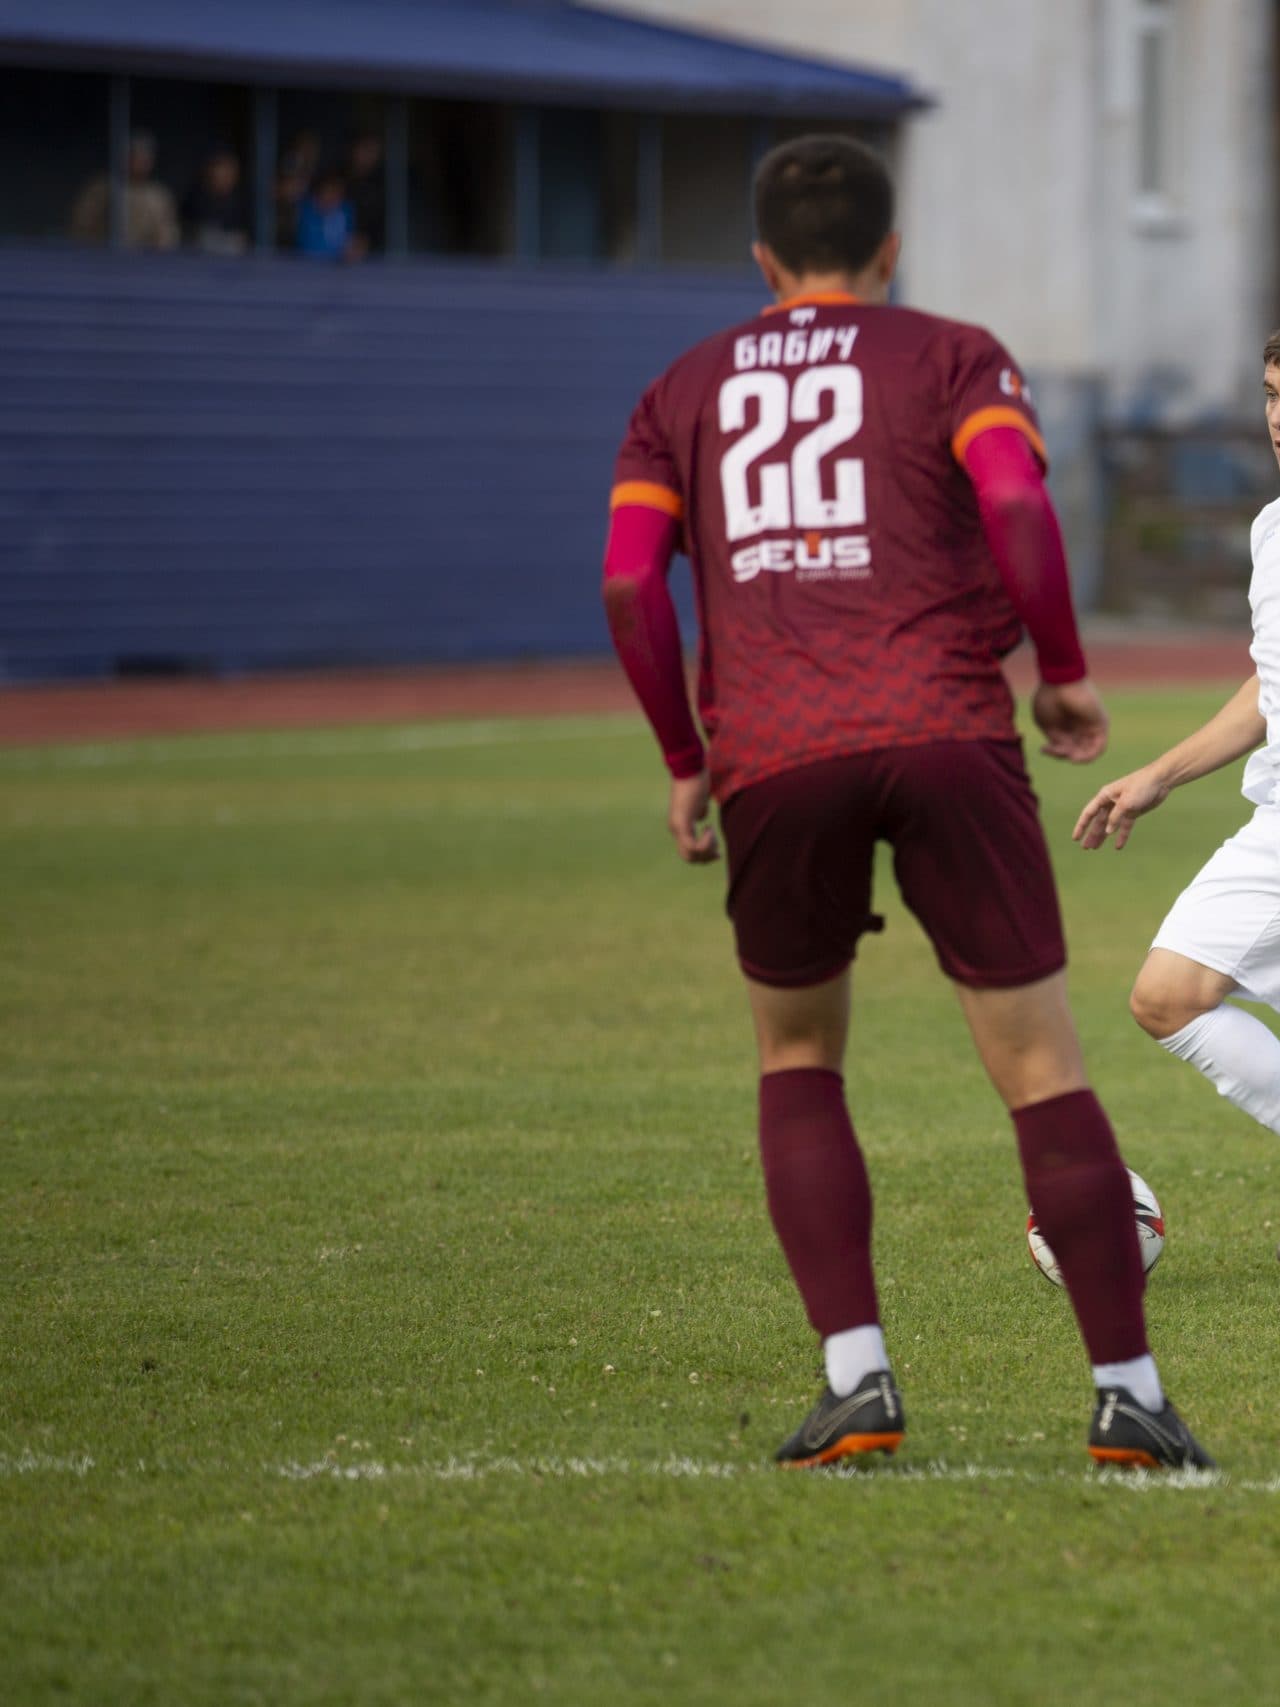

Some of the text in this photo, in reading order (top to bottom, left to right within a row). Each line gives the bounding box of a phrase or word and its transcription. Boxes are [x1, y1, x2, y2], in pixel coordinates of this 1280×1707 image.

[734, 324, 859, 371] БАБИЧ
[718, 364, 867, 541] 22
[731, 534, 872, 583] SEUS
